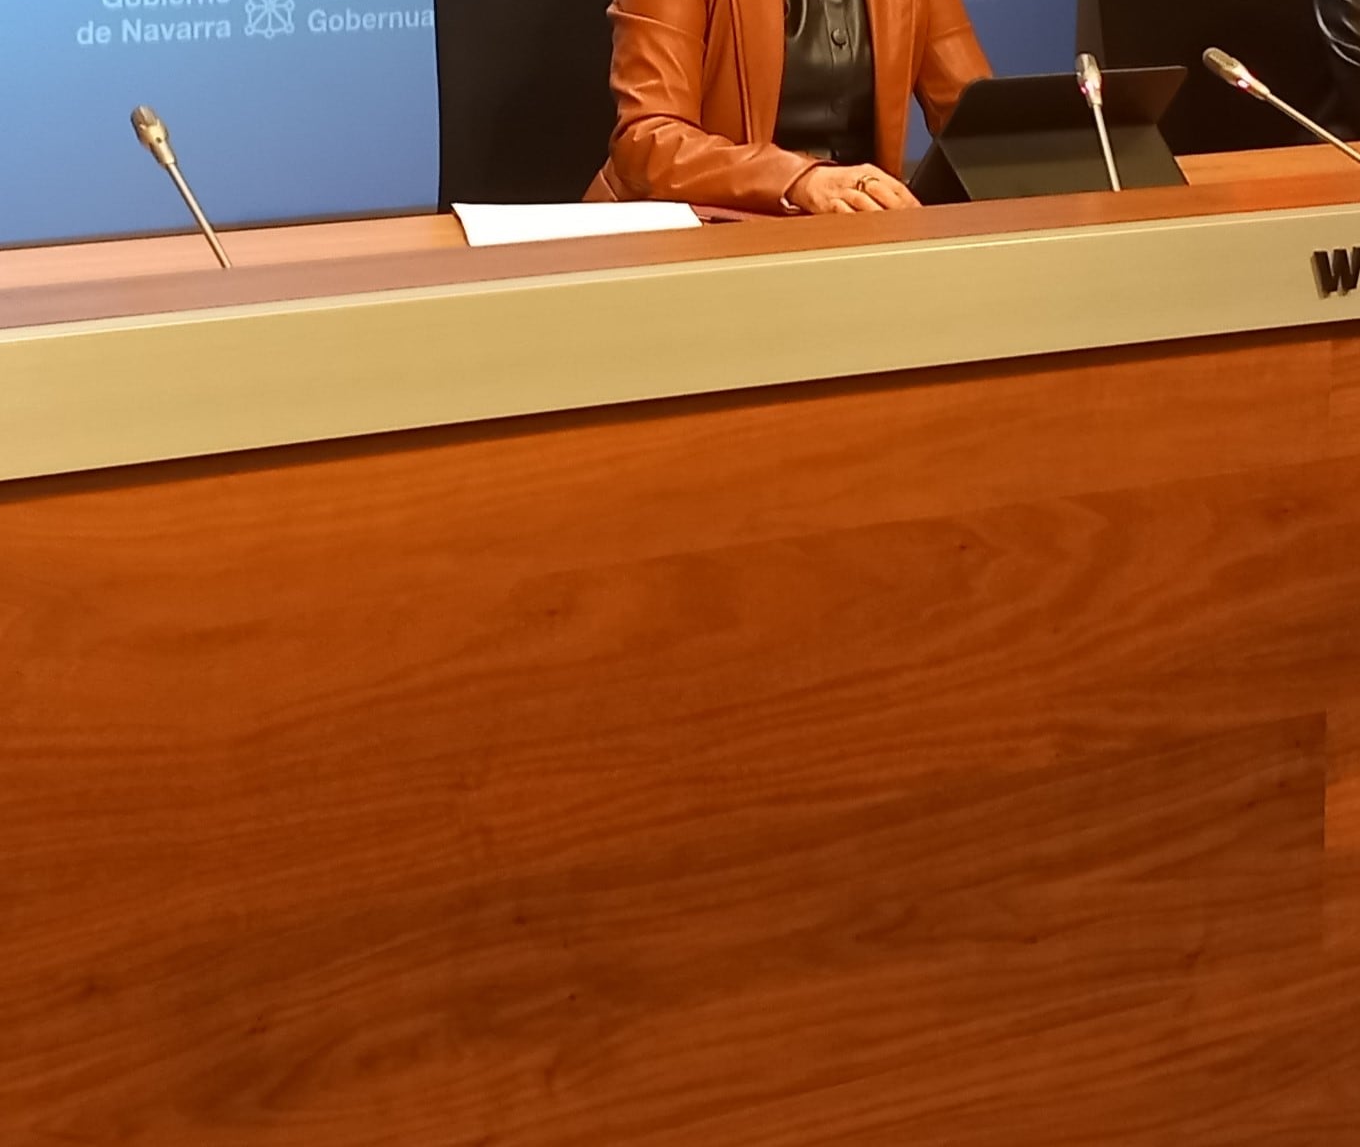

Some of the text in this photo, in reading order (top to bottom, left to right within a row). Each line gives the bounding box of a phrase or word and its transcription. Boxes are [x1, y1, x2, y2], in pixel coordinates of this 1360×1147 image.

[76, 16, 232, 45] de Navarra
[307, 5, 435, 33] Gobernua
